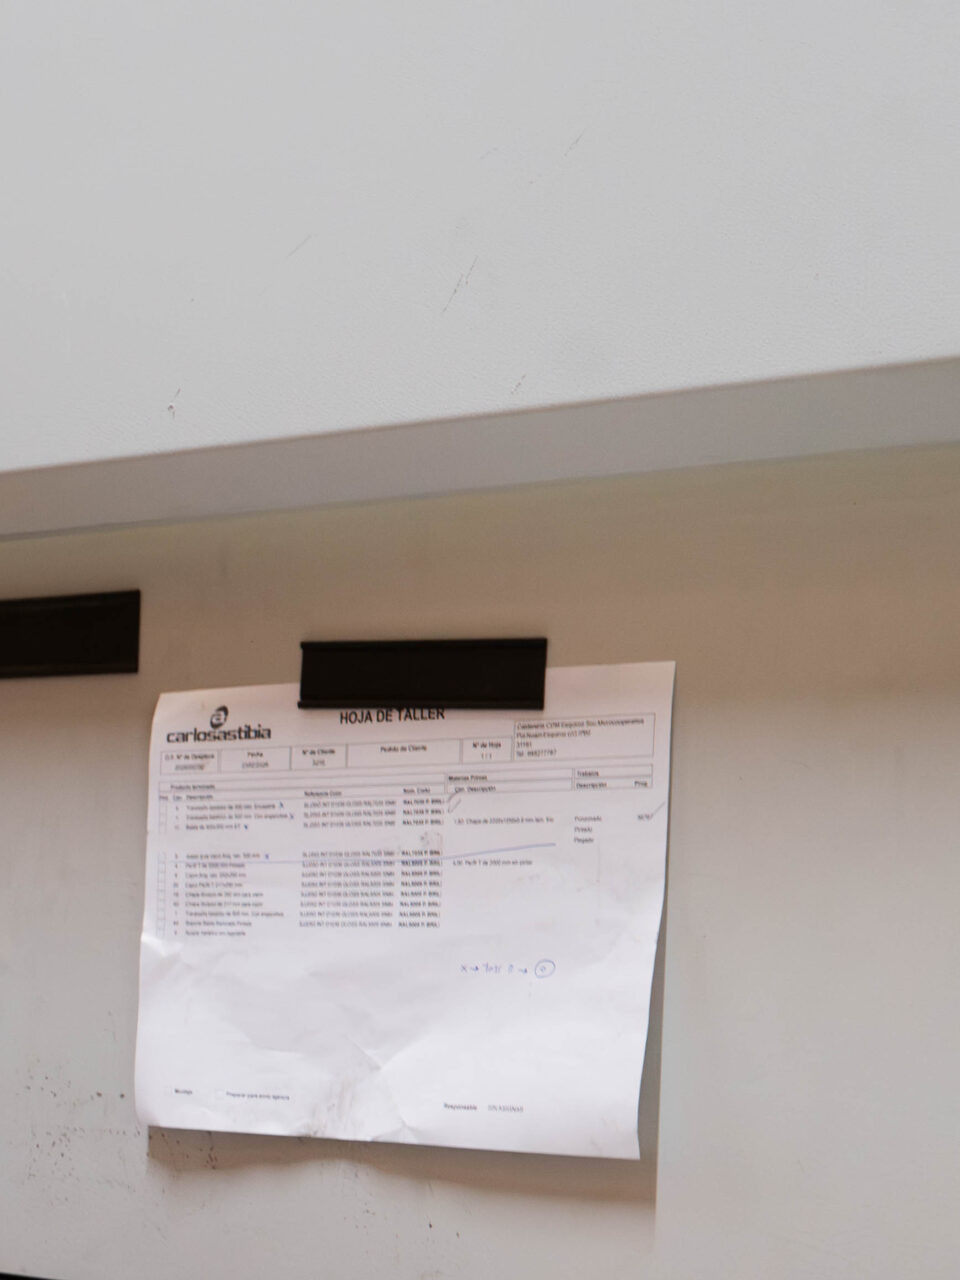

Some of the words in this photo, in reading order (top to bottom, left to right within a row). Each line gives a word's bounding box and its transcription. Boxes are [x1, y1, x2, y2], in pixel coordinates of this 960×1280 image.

[340, 710, 373, 725] HOJA
[376, 708, 393, 723] DE
[397, 705, 445, 722] TALLER
[166, 724, 272, 743] carlosastibia
